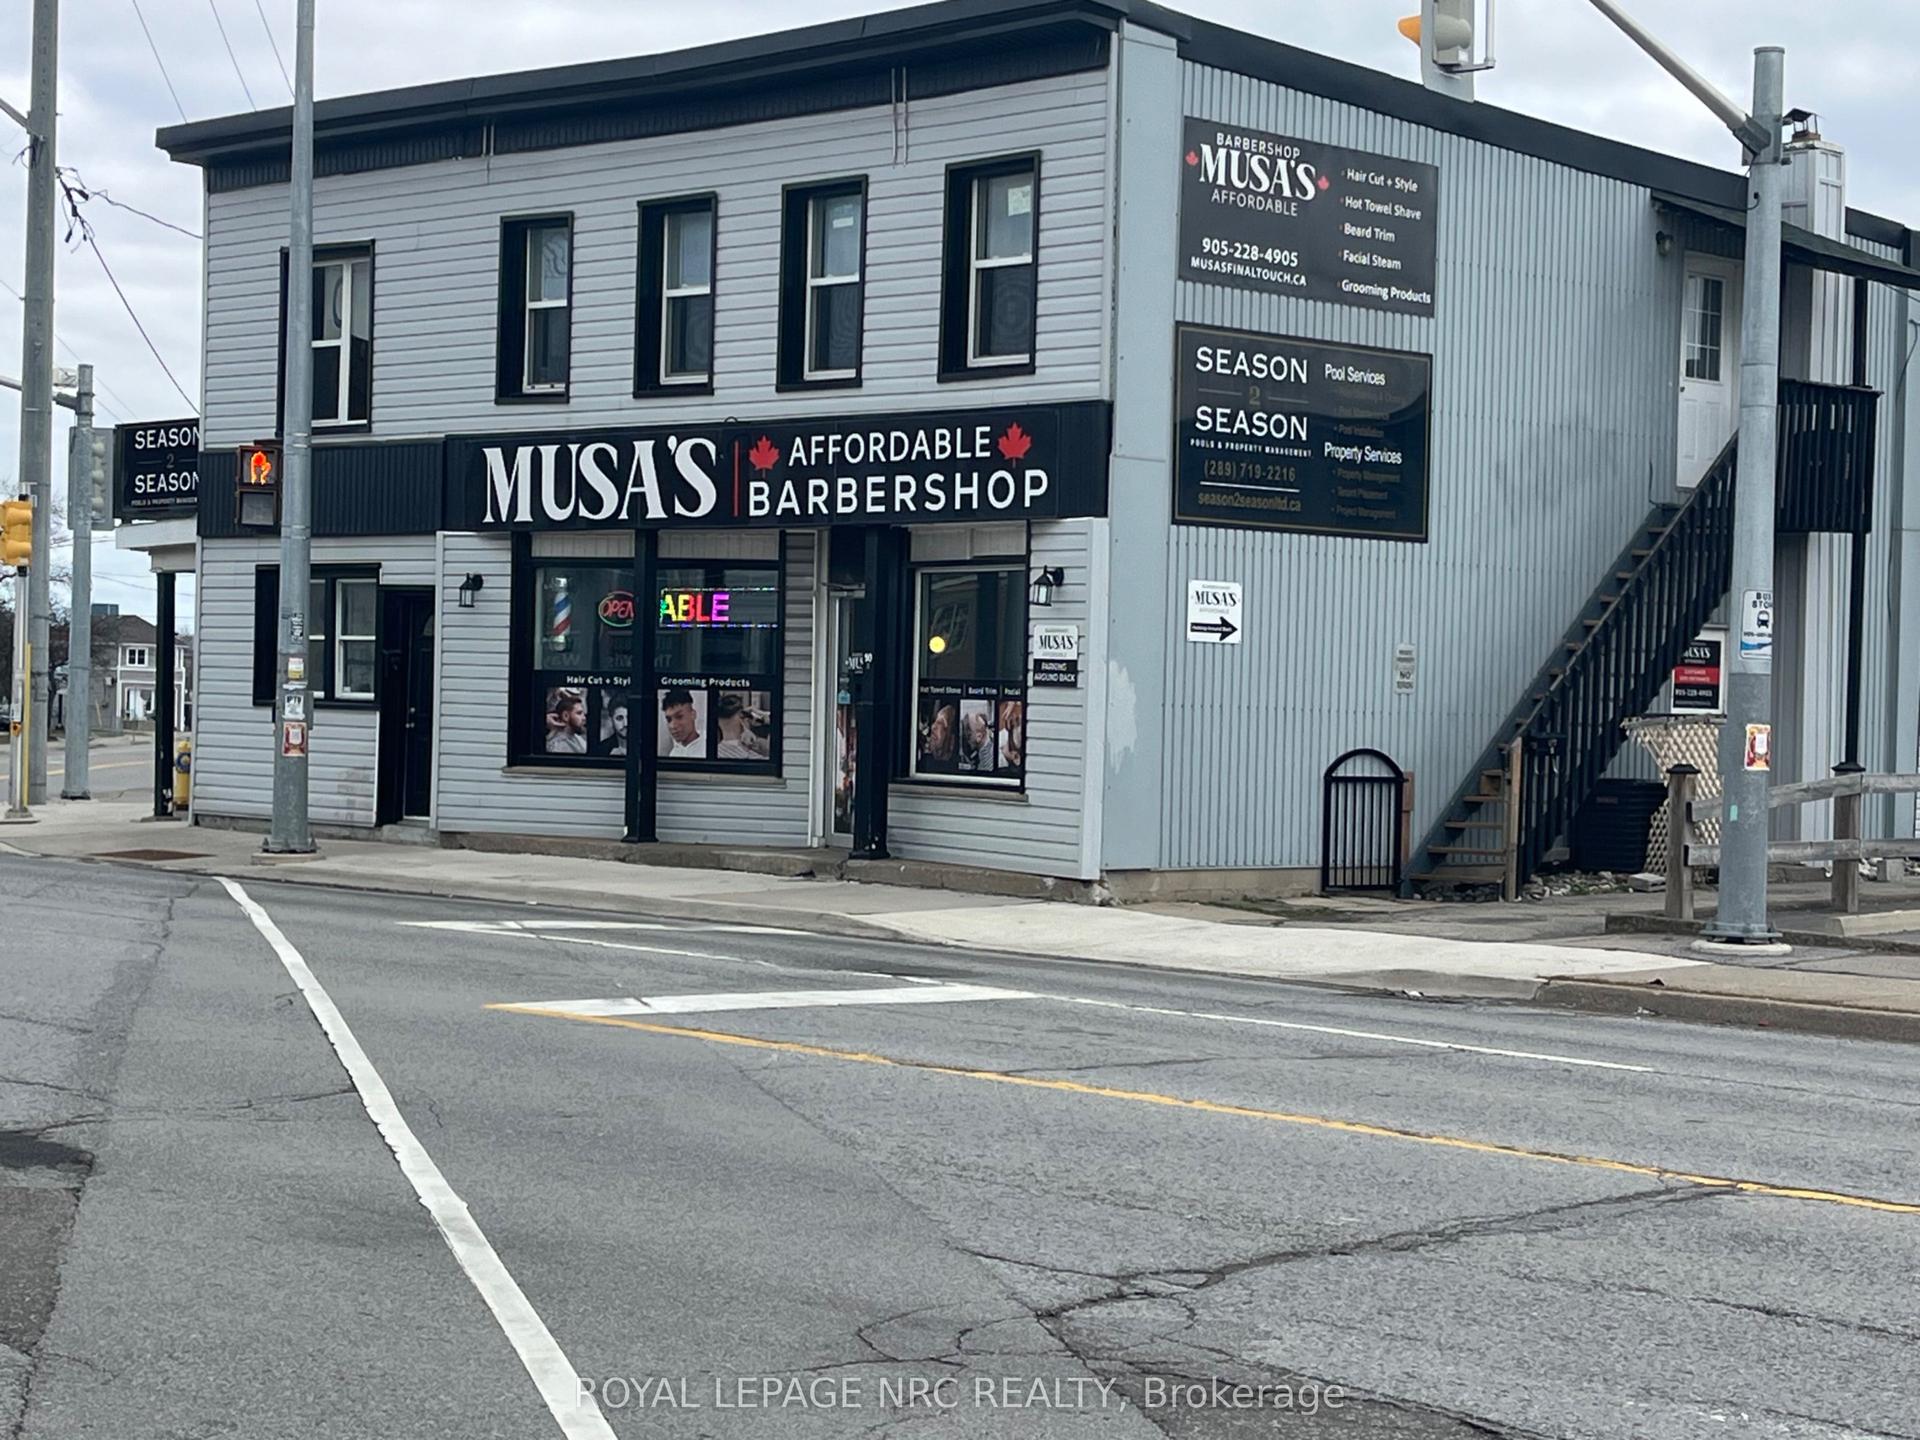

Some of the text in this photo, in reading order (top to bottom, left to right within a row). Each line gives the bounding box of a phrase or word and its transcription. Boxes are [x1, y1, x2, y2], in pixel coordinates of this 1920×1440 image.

[1216, 132, 1300, 159] BARBERSHOP
[1199, 143, 1316, 201] MUSA'S
[1347, 168, 1418, 193] Hair Cut + Style
[1211, 188, 1298, 216] AFFORDABLE
[1345, 195, 1422, 220] Hot Towel Shave
[1344, 222, 1396, 242] Beard Trim
[1202, 237, 1299, 267] 905-228-4905
[1343, 249, 1402, 270] Facial Steam
[1191, 256, 1307, 287] MUSASFINALTOUCH.CA
[1341, 279, 1431, 304] Grooming Products
[1195, 346, 1308, 384] SEASON
[1324, 363, 1386, 387] Pool Services
[1249, 385, 1261, 406] 2
[1195, 405, 1307, 441] SEASON
[134, 426, 200, 450] SEASON
[788, 425, 992, 468] AFFORDABLE
[1190, 438, 1215, 449] POOLS
[1225, 441, 1262, 453] PROPERTY
[1265, 445, 1312, 457] MANAGEMENT
[166, 452, 175, 469] 2
[1324, 441, 1403, 465] Property Services
[134, 471, 200, 494] SEASON
[481, 434, 718, 524] MUSA'S
[1204, 459, 1296, 482] (289) 719-2216
[748, 468, 1050, 518] BARBERSHOP
[601, 599, 634, 619] OPEN
[660, 593, 730, 622] ABLE
[566, 675, 586, 684] Hair
[587, 675, 603, 685] Cut
[613, 675, 632, 687] Styl
[660, 677, 751, 688] Grooming Products
